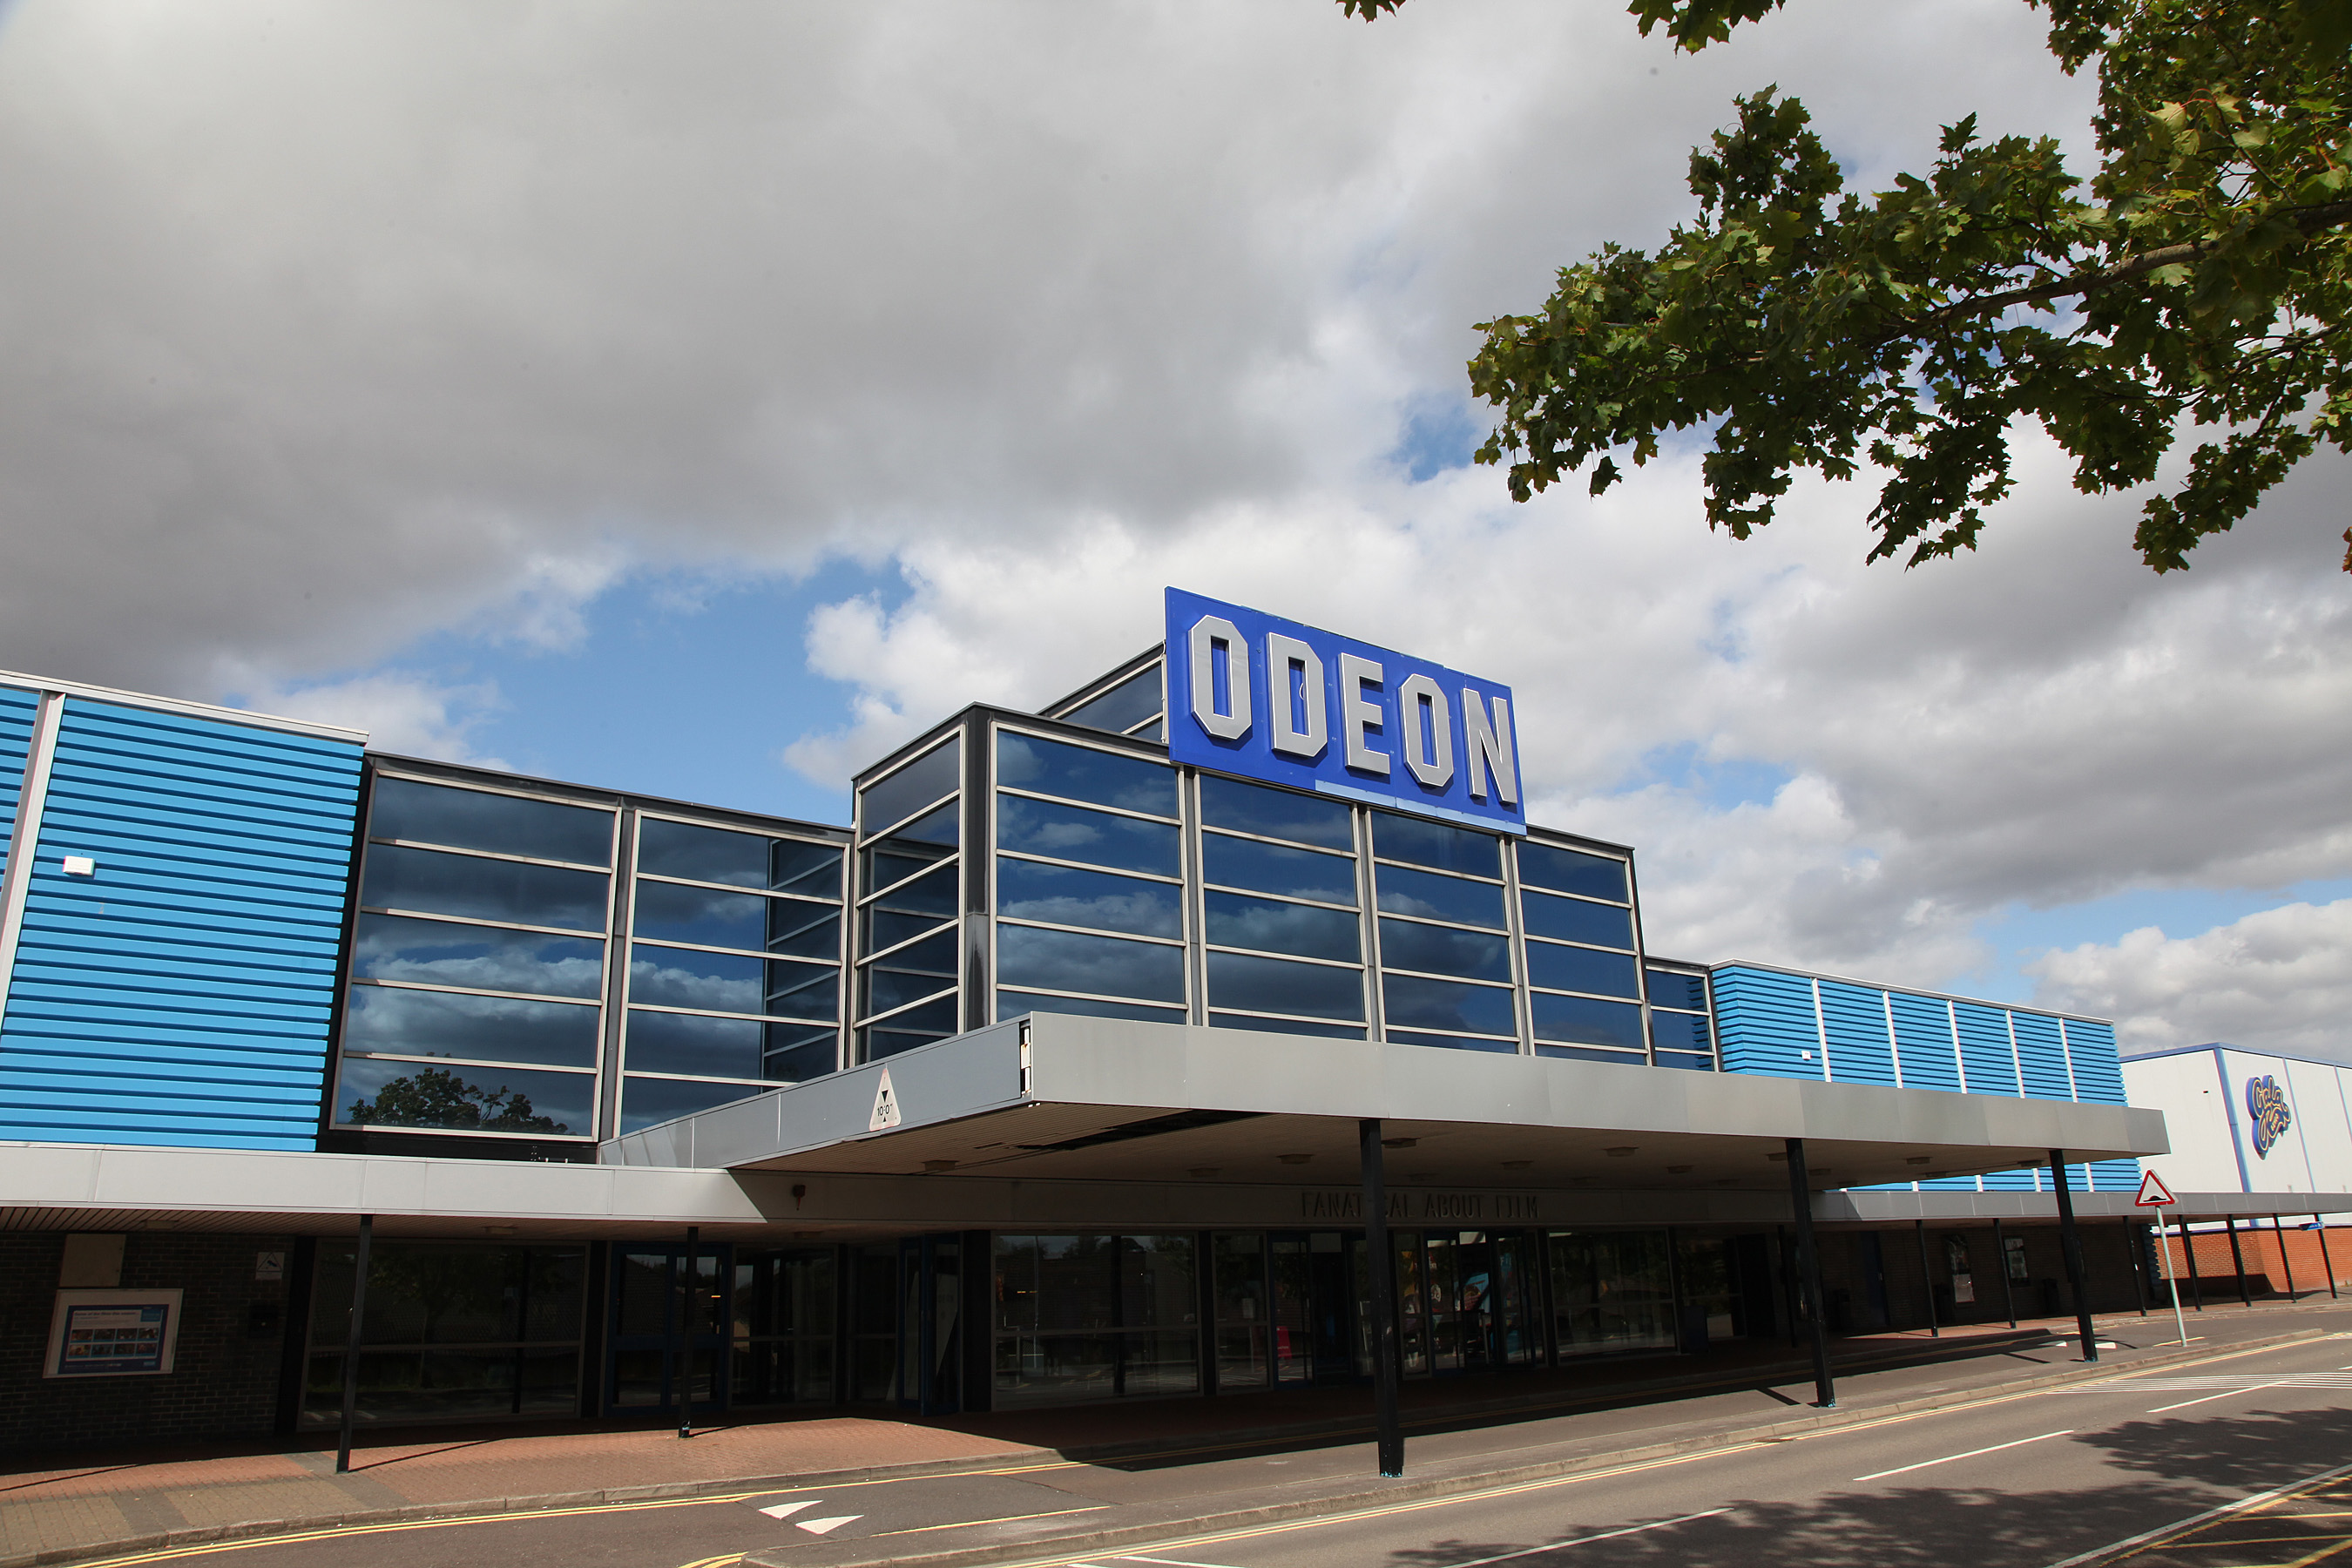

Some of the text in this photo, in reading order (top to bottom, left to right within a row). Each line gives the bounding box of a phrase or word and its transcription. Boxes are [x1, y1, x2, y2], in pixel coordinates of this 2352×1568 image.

[1189, 615, 1517, 803] ODEON
[1300, 1191, 1540, 1220] FANATAL ABOUT FILM
